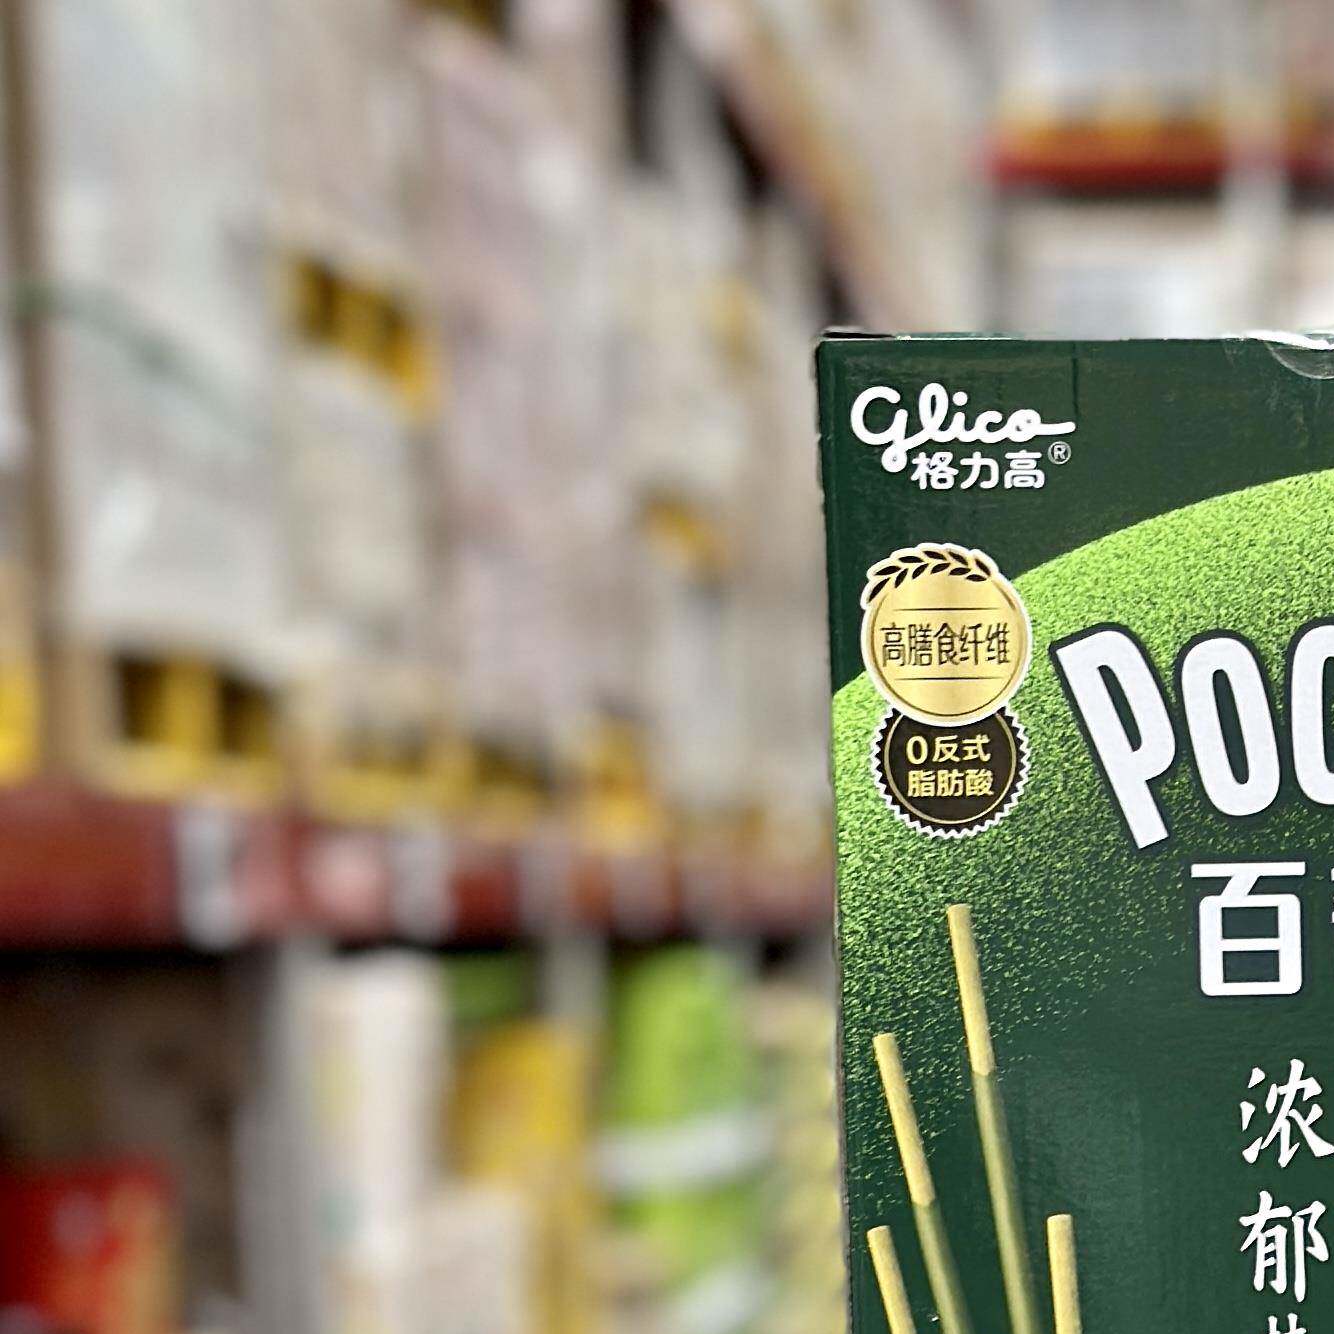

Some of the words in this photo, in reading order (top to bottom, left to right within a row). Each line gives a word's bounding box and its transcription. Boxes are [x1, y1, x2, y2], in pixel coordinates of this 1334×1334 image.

[851, 383, 1076, 473] Glico
[911, 450, 1046, 490] 格力高
[880, 622, 1012, 668] 高膳食纤维
[906, 734, 992, 765] 0反式
[907, 769, 994, 798] 脂肪酸
